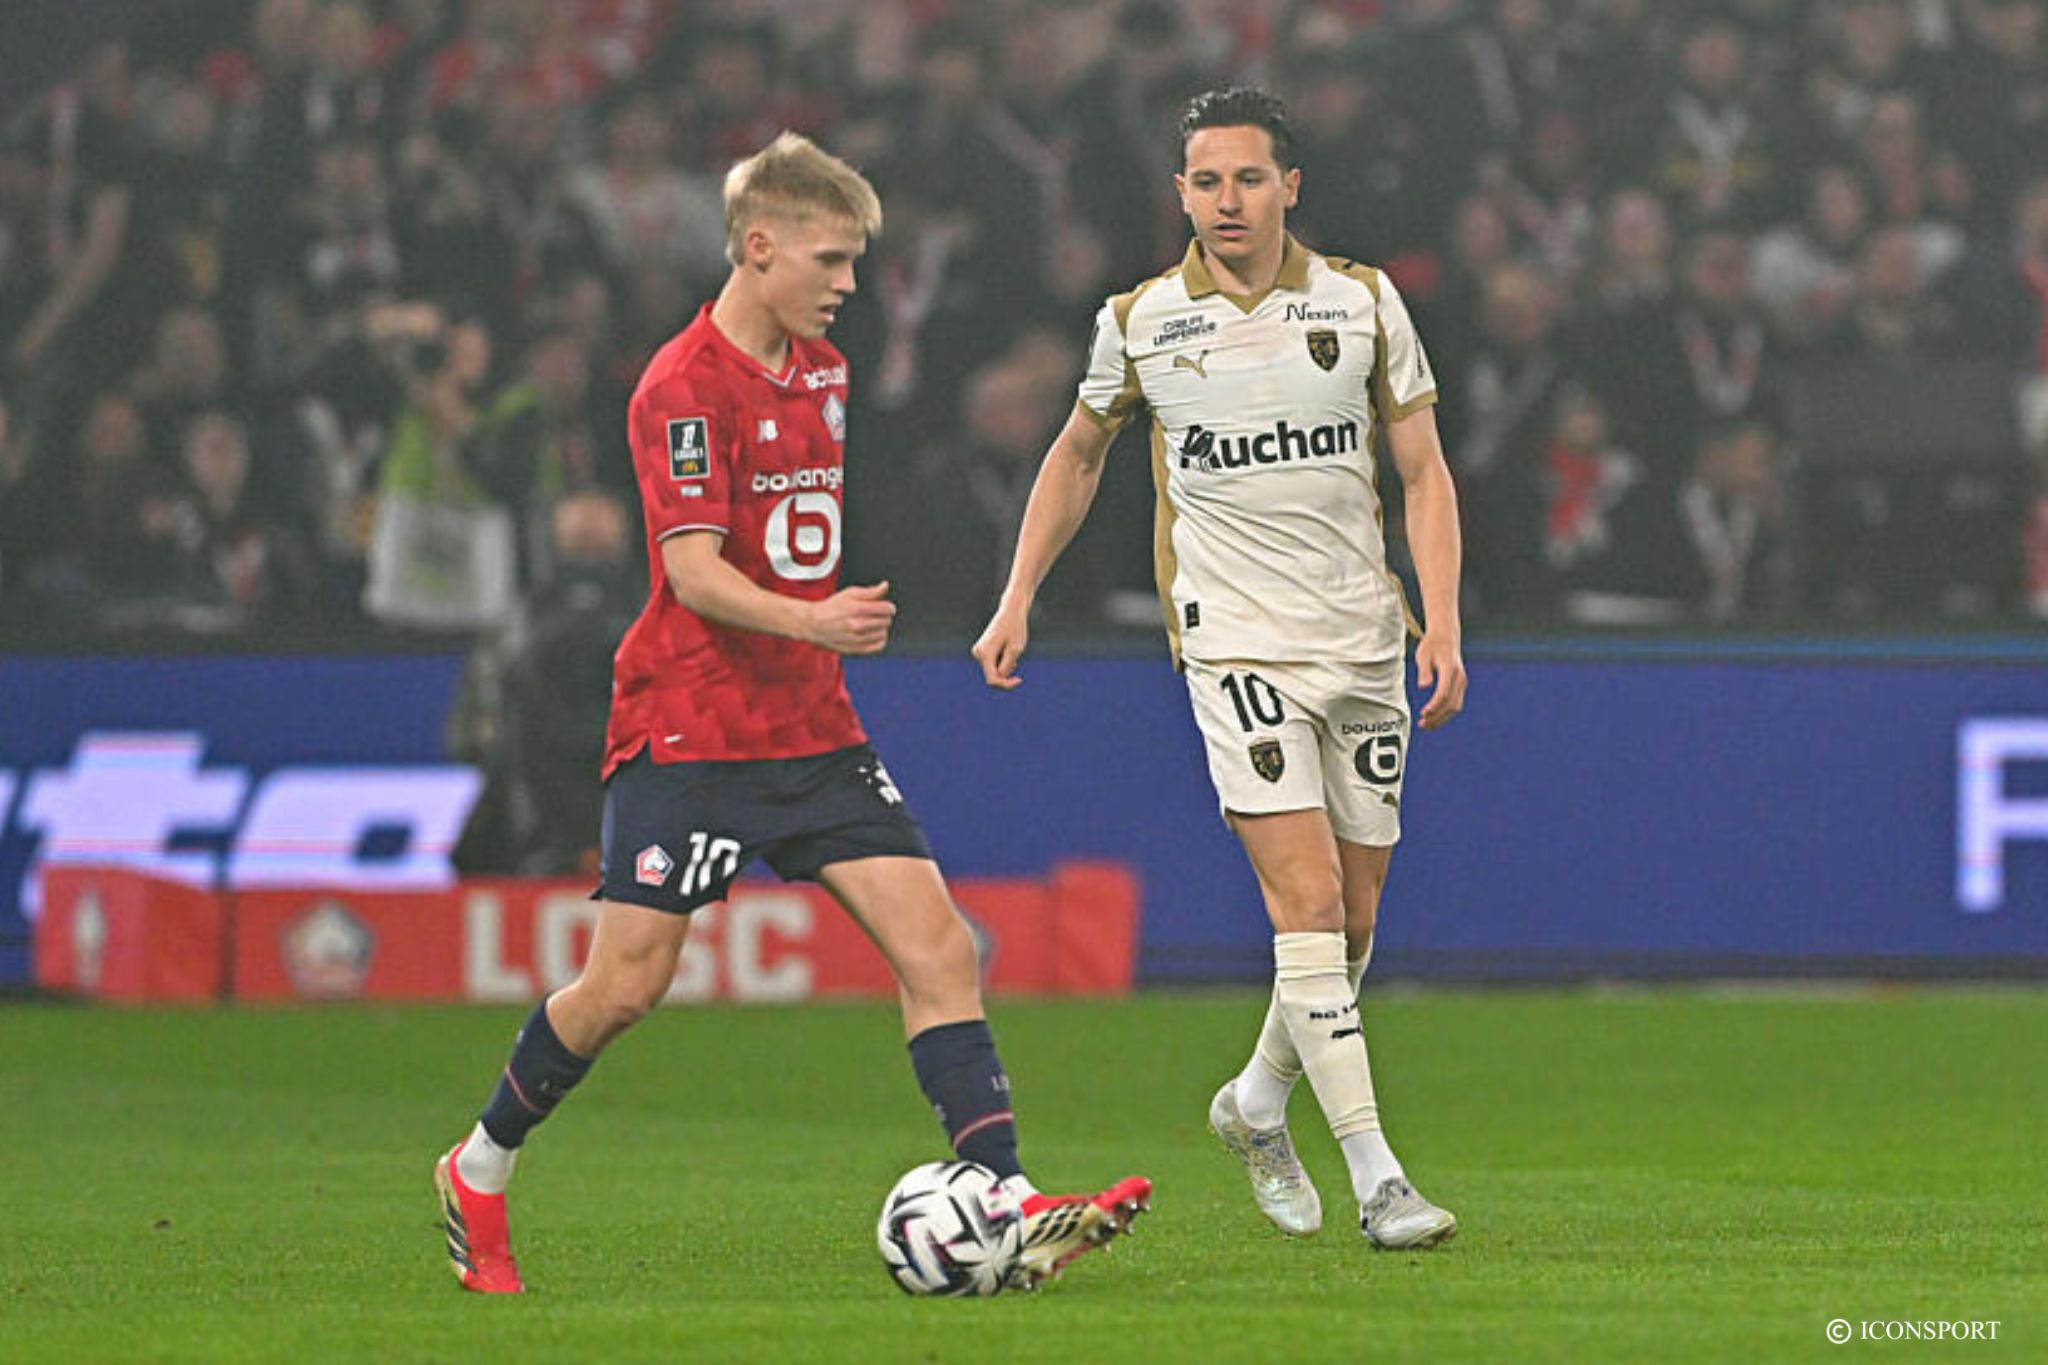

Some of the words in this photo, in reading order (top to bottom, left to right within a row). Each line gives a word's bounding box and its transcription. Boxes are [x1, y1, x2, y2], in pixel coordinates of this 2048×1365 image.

[1284, 302, 1348, 322] Nexans
[1180, 420, 1359, 471] Auchan
[1220, 672, 1286, 733] 10
